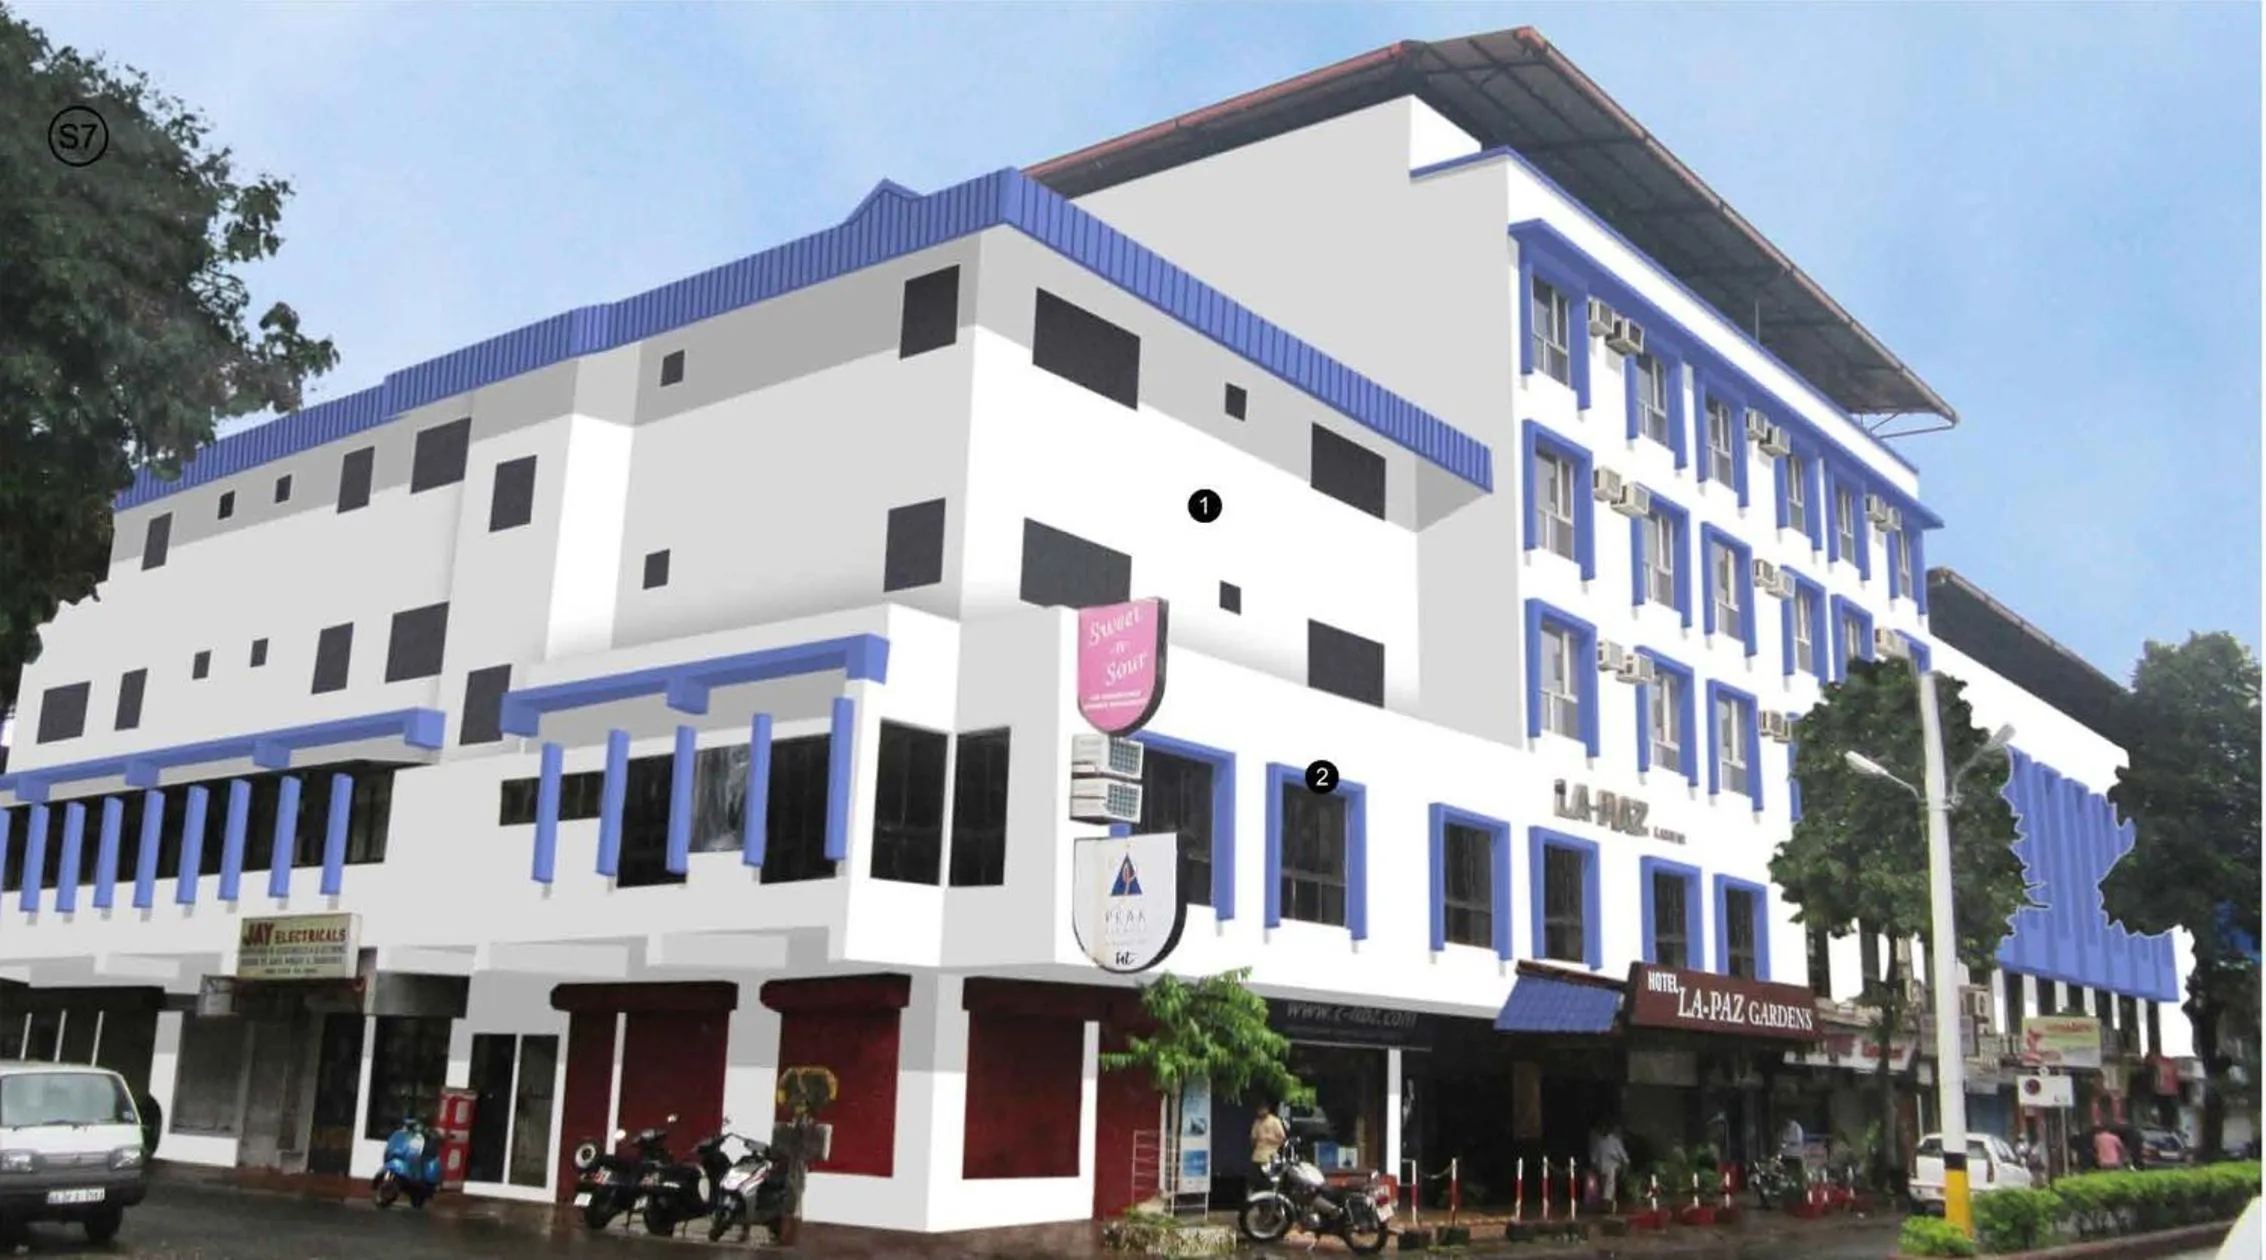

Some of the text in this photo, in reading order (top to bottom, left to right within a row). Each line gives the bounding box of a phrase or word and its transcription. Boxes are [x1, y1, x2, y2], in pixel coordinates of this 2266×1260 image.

[1089, 605, 1145, 646] Sweet
[1105, 653, 1148, 686] Sour
[1554, 778, 1649, 837] LA-PAZ
[242, 922, 346, 946] JAY ELECTRICALS
[1648, 970, 1679, 994] HOTEL
[1677, 986, 1813, 1031] LA-PAZ GARDENS
